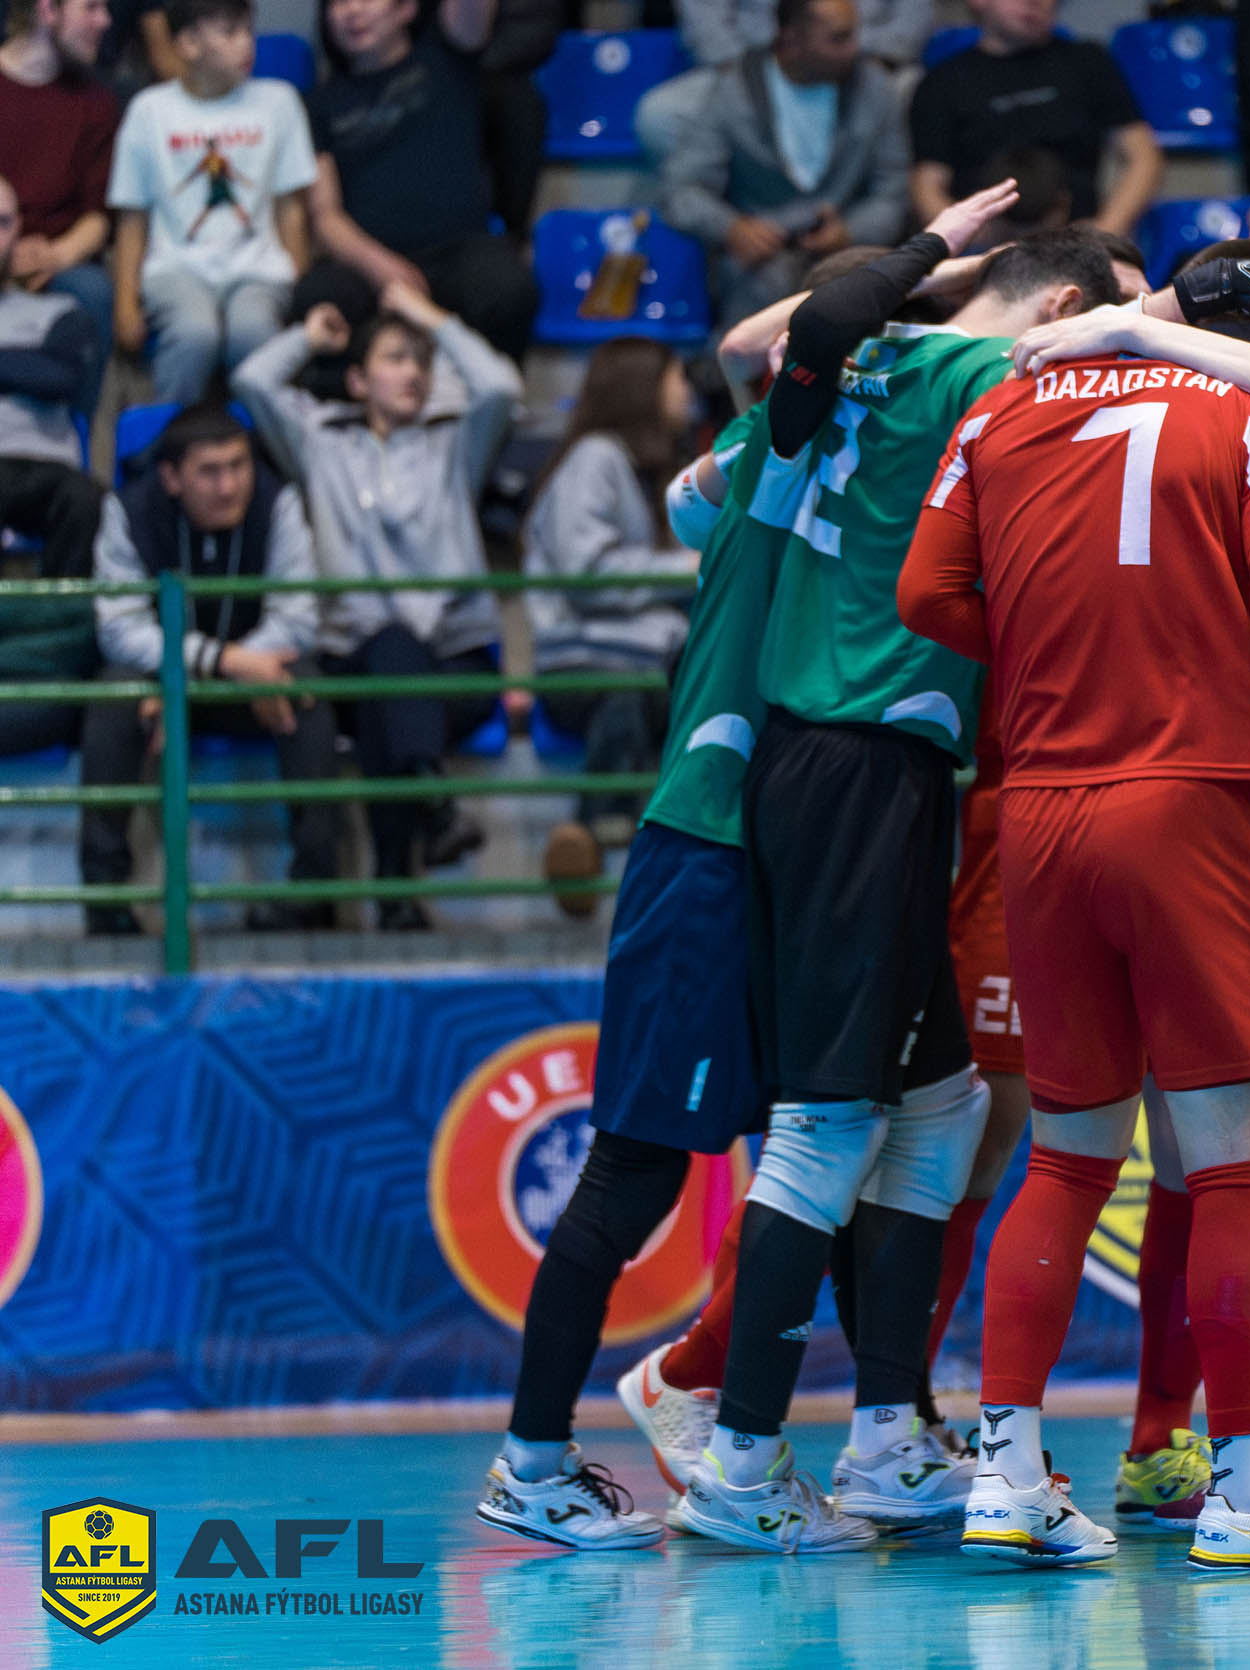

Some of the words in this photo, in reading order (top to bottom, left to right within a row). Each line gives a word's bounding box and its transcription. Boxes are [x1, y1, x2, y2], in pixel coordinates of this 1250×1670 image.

[1034, 367, 1234, 404] QAZAQSTAN
[1071, 402, 1169, 566] 7
[487, 1050, 582, 1119] UE
